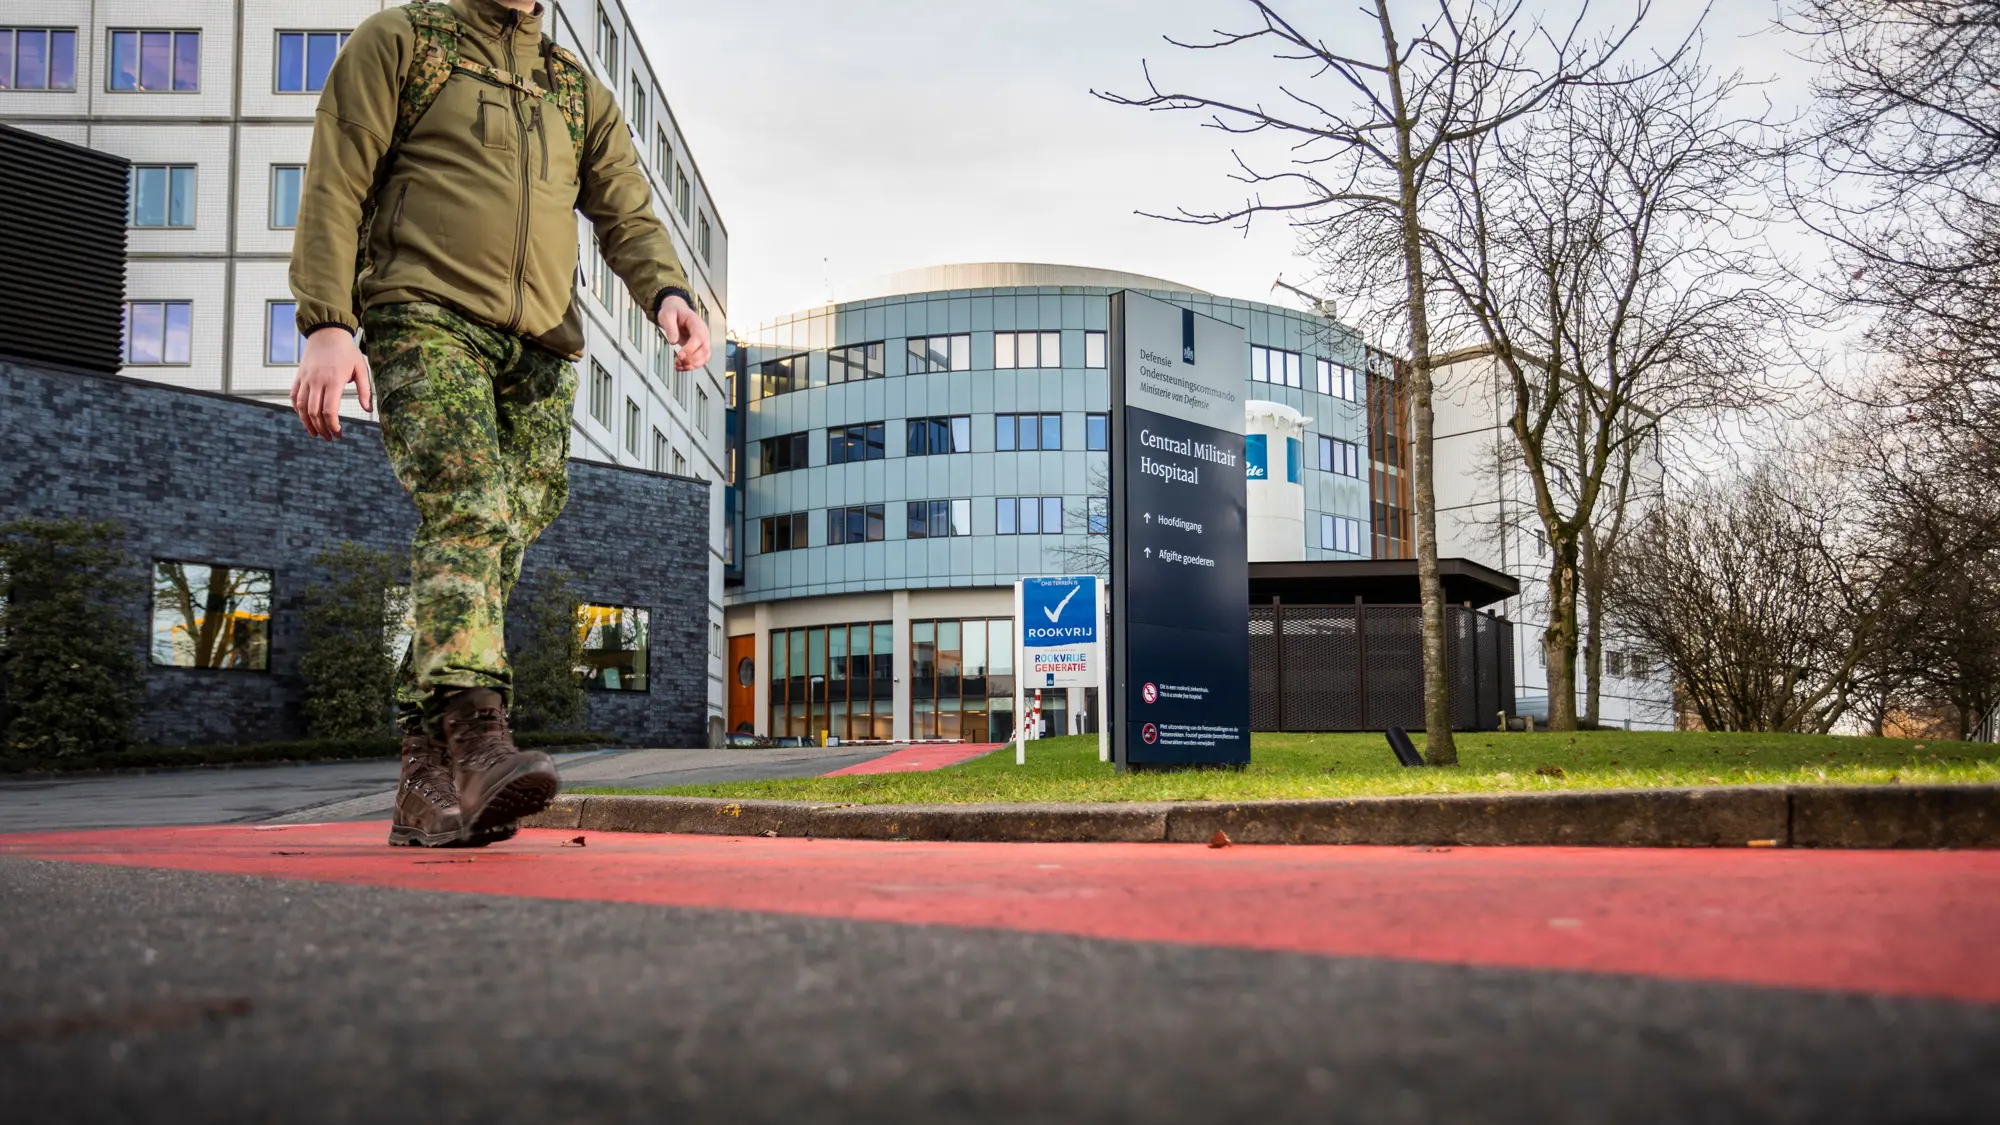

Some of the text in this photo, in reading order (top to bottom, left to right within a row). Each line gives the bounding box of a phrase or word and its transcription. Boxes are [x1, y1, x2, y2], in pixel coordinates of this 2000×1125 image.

[1140, 349, 1172, 368] Defensie
[1140, 366, 1235, 402] Ondersteuningscommando
[1140, 382, 1209, 410] Ministerie van Defensie
[1140, 429, 1236, 467] Centraal Militair
[1141, 456, 1198, 484] Hospitaal
[1158, 514, 1202, 534] Hoofdingang
[1159, 549, 1214, 567] Afgifte goederen
[1028, 627, 1092, 638] ROOKVRIJ
[1034, 653, 1086, 663] ROOKVRIJE
[1035, 663, 1087, 673] GENERATIE
